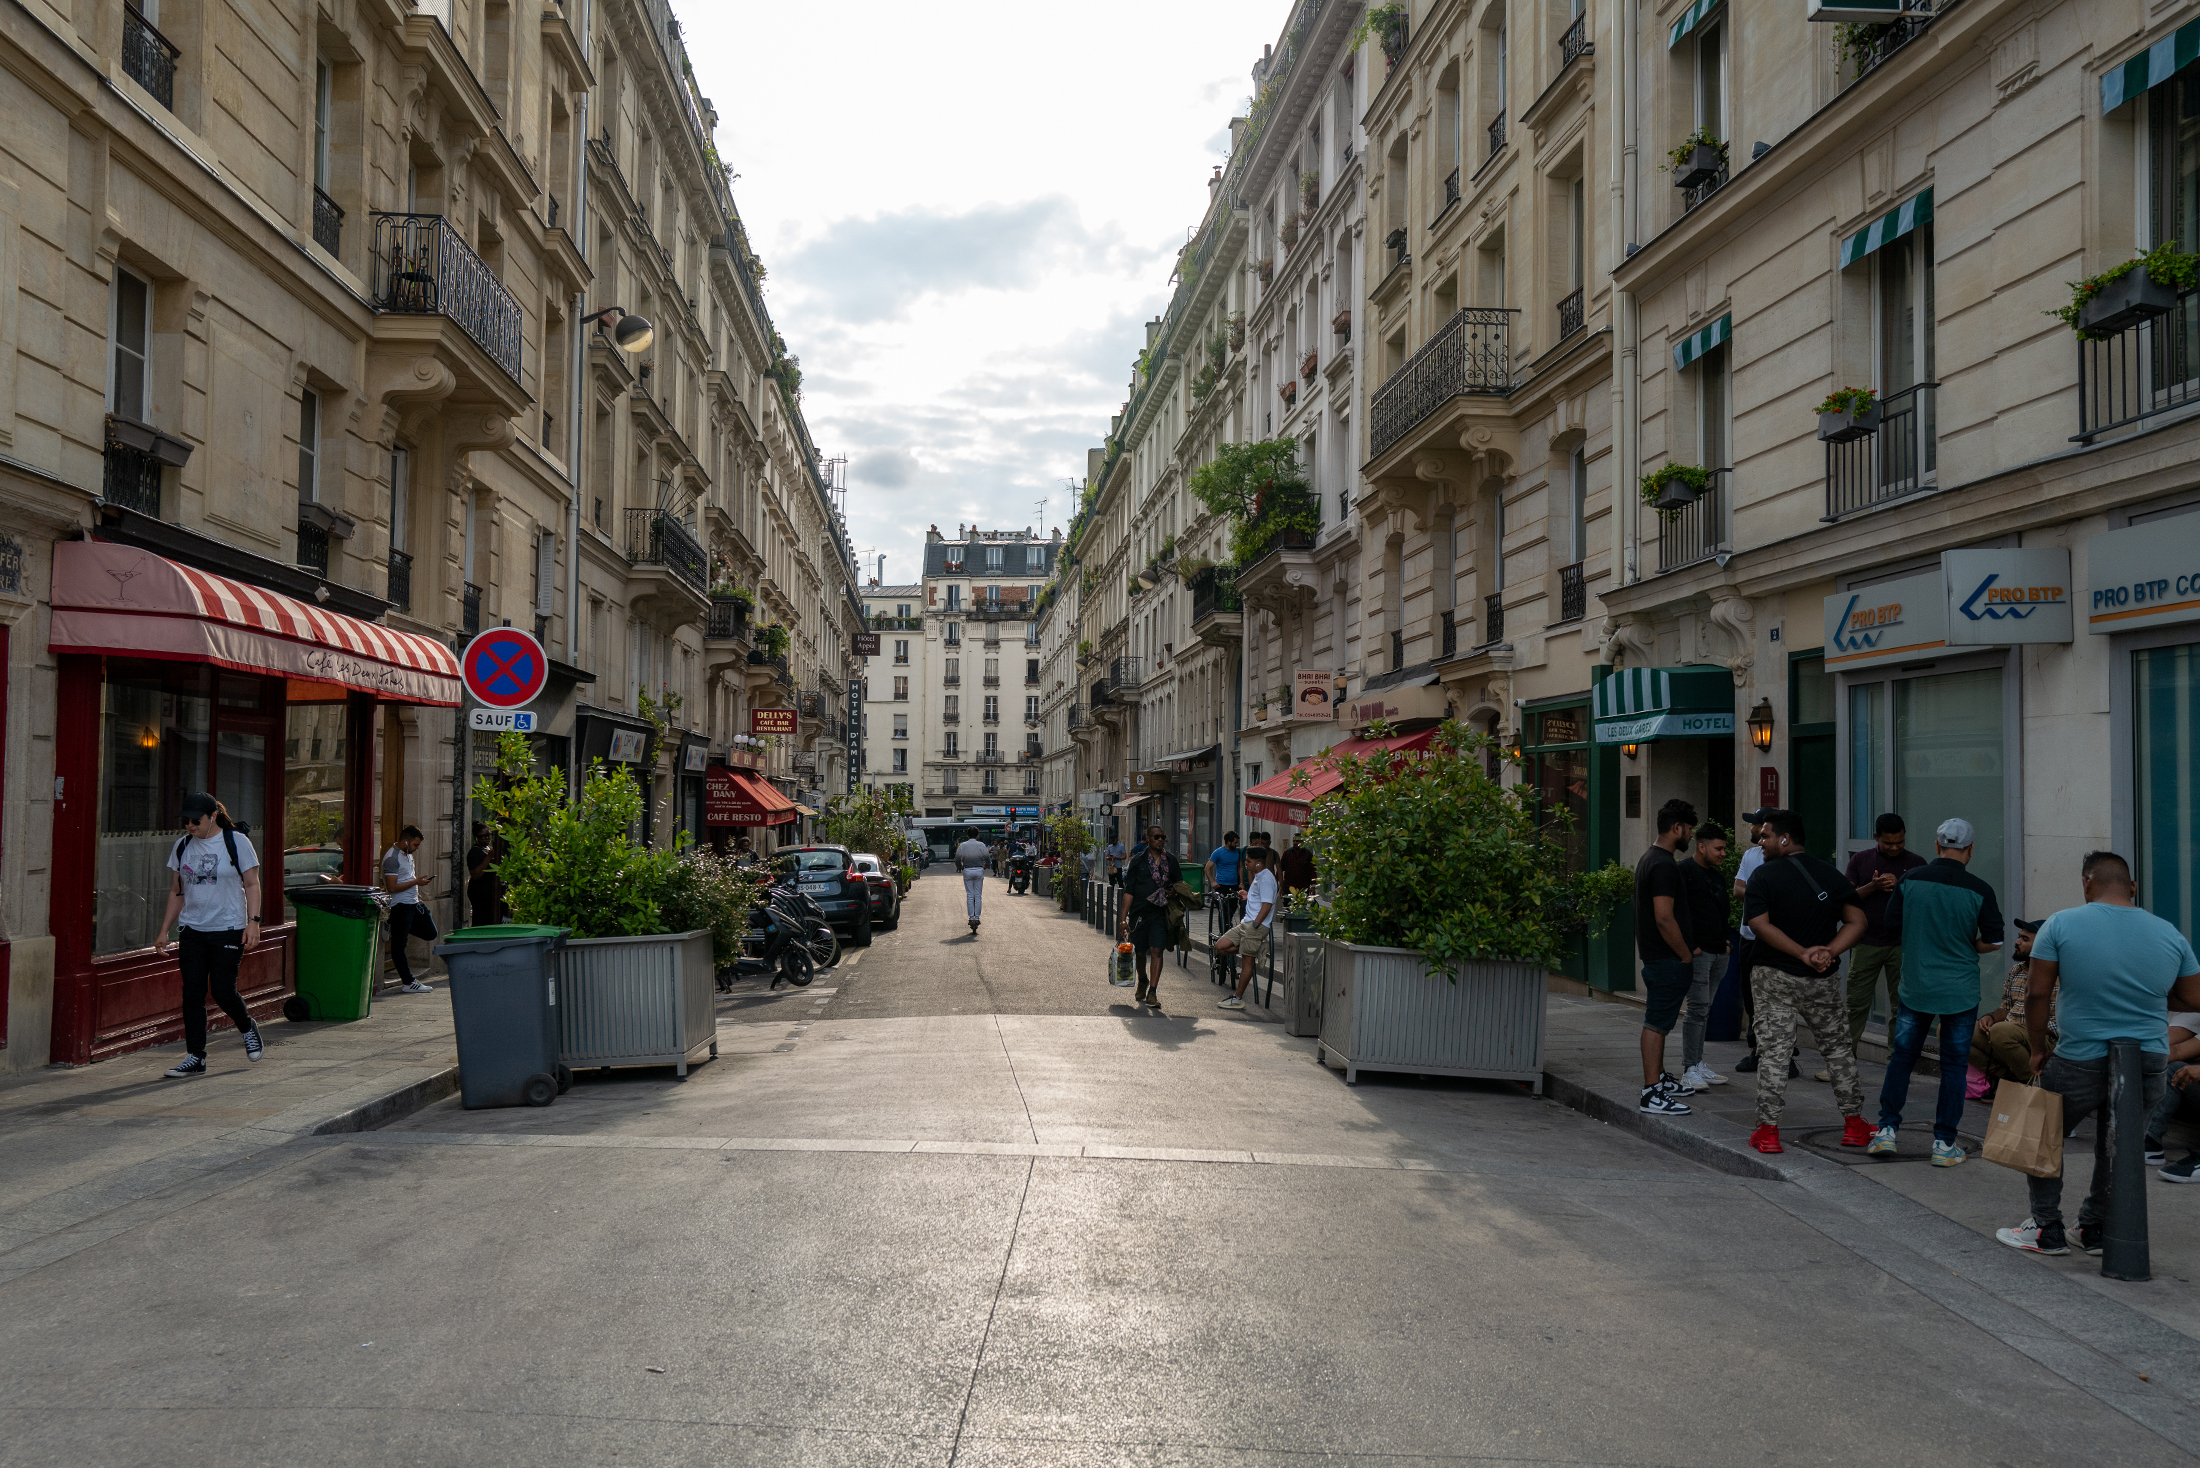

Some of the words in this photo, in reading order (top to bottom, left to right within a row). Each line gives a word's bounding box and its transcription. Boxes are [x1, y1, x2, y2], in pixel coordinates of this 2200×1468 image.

[1988, 587, 2025, 602] PRO
[2028, 586, 2063, 601] BTP
[2094, 586, 2129, 609] PRO
[2134, 579, 2169, 602] BTP
[1851, 608, 1875, 628] PRO
[1877, 603, 1901, 623] BTP
[857, 642, 875, 650] Appia
[306, 650, 333, 673] Café
[352, 662, 375, 679] Deux
[851, 683, 859, 725] HOTEL
[475, 713, 512, 726] SAUF
[757, 711, 792, 720] DELLY'S
[1607, 726, 1617, 738] LES
[1618, 724, 1633, 737] DEUX
[1634, 721, 1652, 735] GARES
[1682, 717, 1730, 730] HOTEL
[850, 732, 859, 790] D'AMIENS
[706, 782, 729, 790] CHEZ
[1767, 775, 1777, 790] H
[713, 790, 736, 798] DANY
[707, 812, 730, 821] CAFÉ
[732, 813, 761, 821] RESTO
